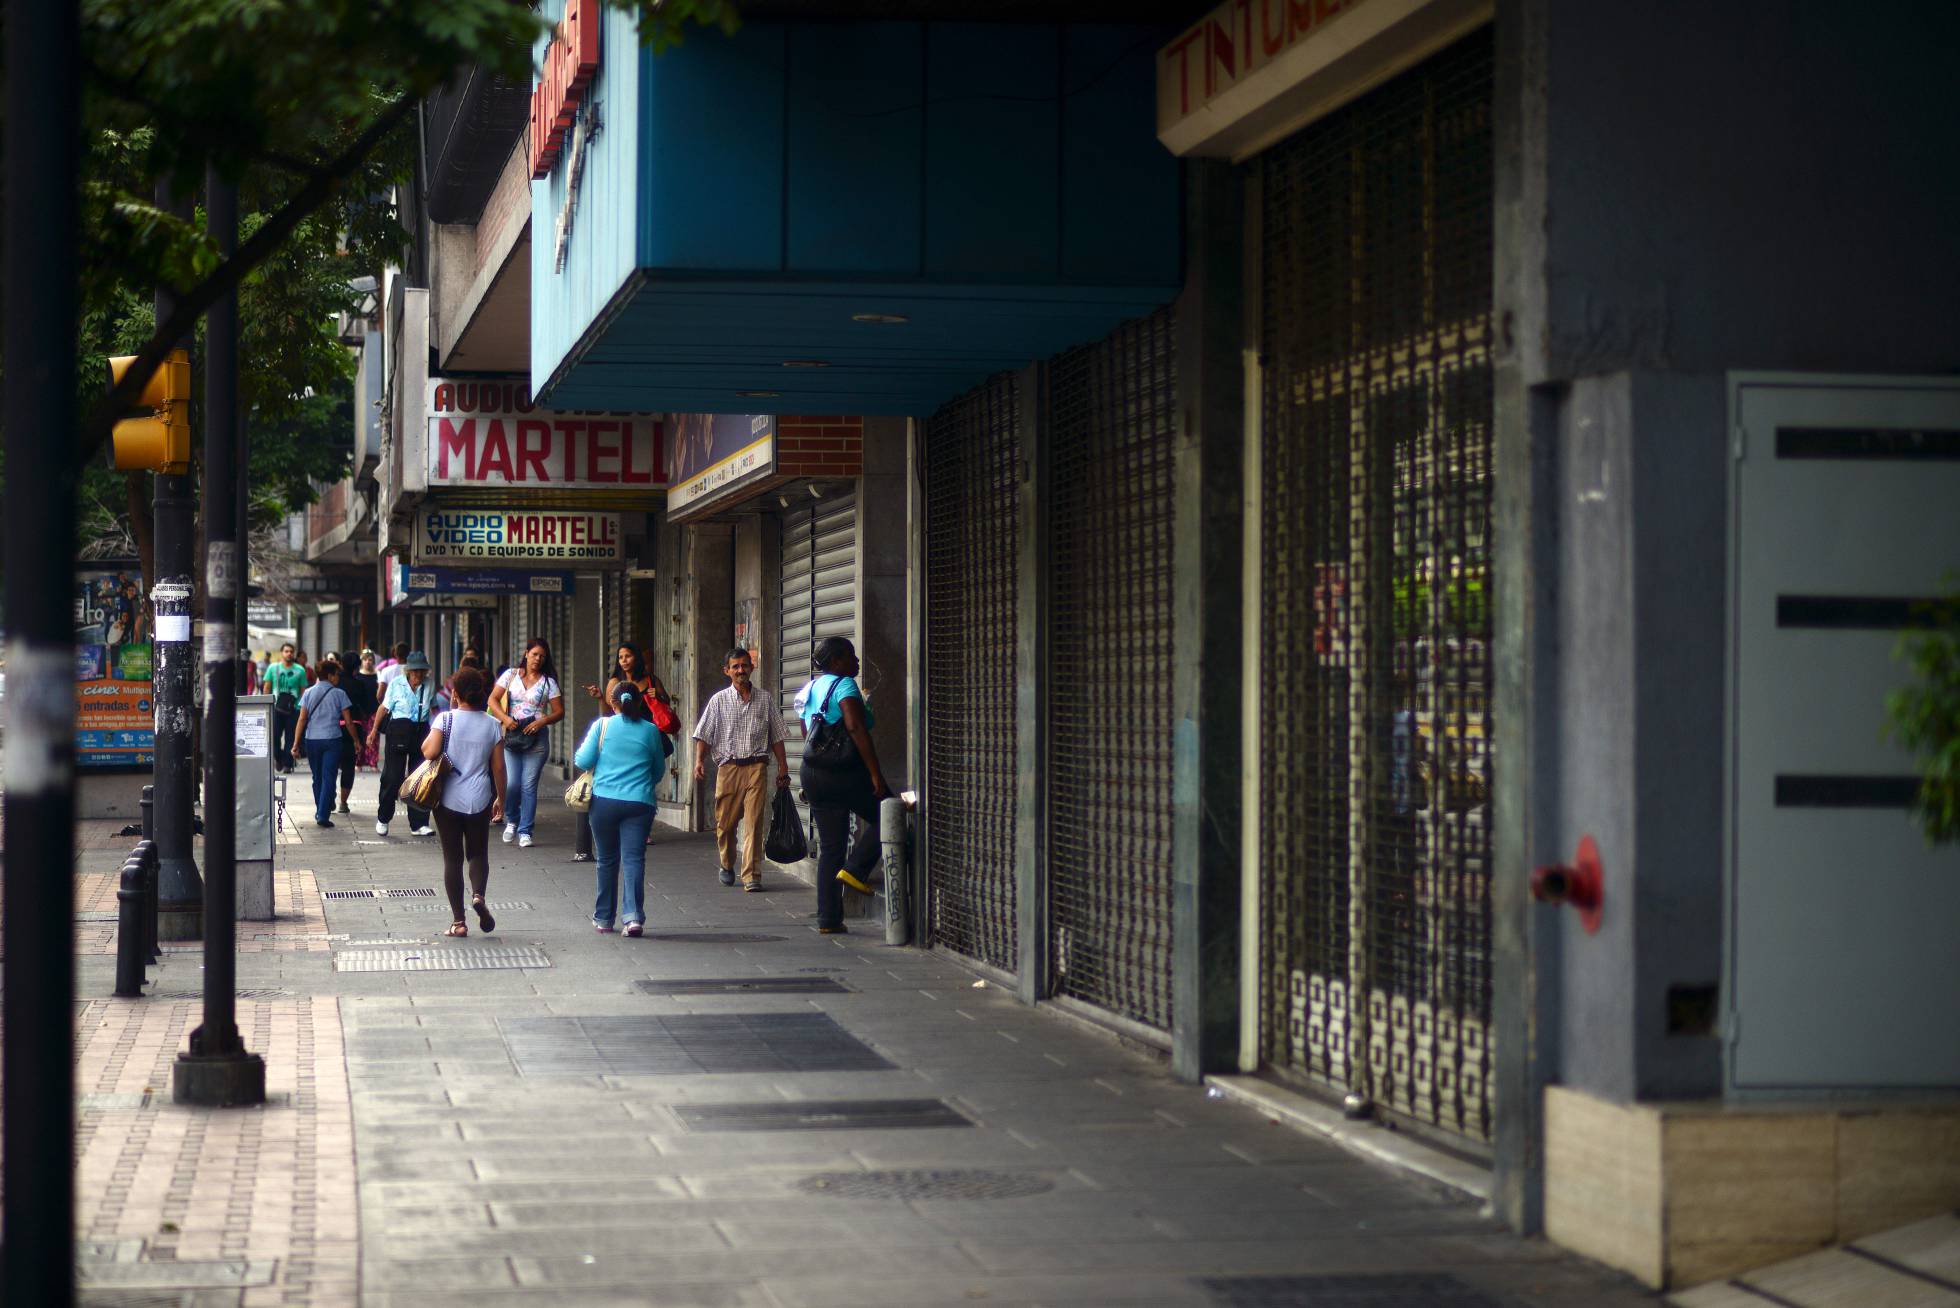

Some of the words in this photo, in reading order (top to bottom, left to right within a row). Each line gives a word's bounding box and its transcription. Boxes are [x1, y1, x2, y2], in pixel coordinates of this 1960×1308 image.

[434, 382, 536, 414] AUDIO
[438, 419, 669, 483] MARTELL
[426, 514, 504, 529] AUDIO
[426, 529, 504, 544] VIDEO
[507, 515, 616, 545] MARTELL
[425, 545, 446, 555] DVD
[451, 545, 465, 556] TV
[469, 546, 484, 556] CD
[488, 546, 544, 558] EQUIPOS
[547, 546, 565, 557] DE
[568, 547, 616, 558] SONIDO
[532, 577, 560, 587] EPSON
[83, 684, 120, 696] cinex
[83, 699, 130, 712] entradas
